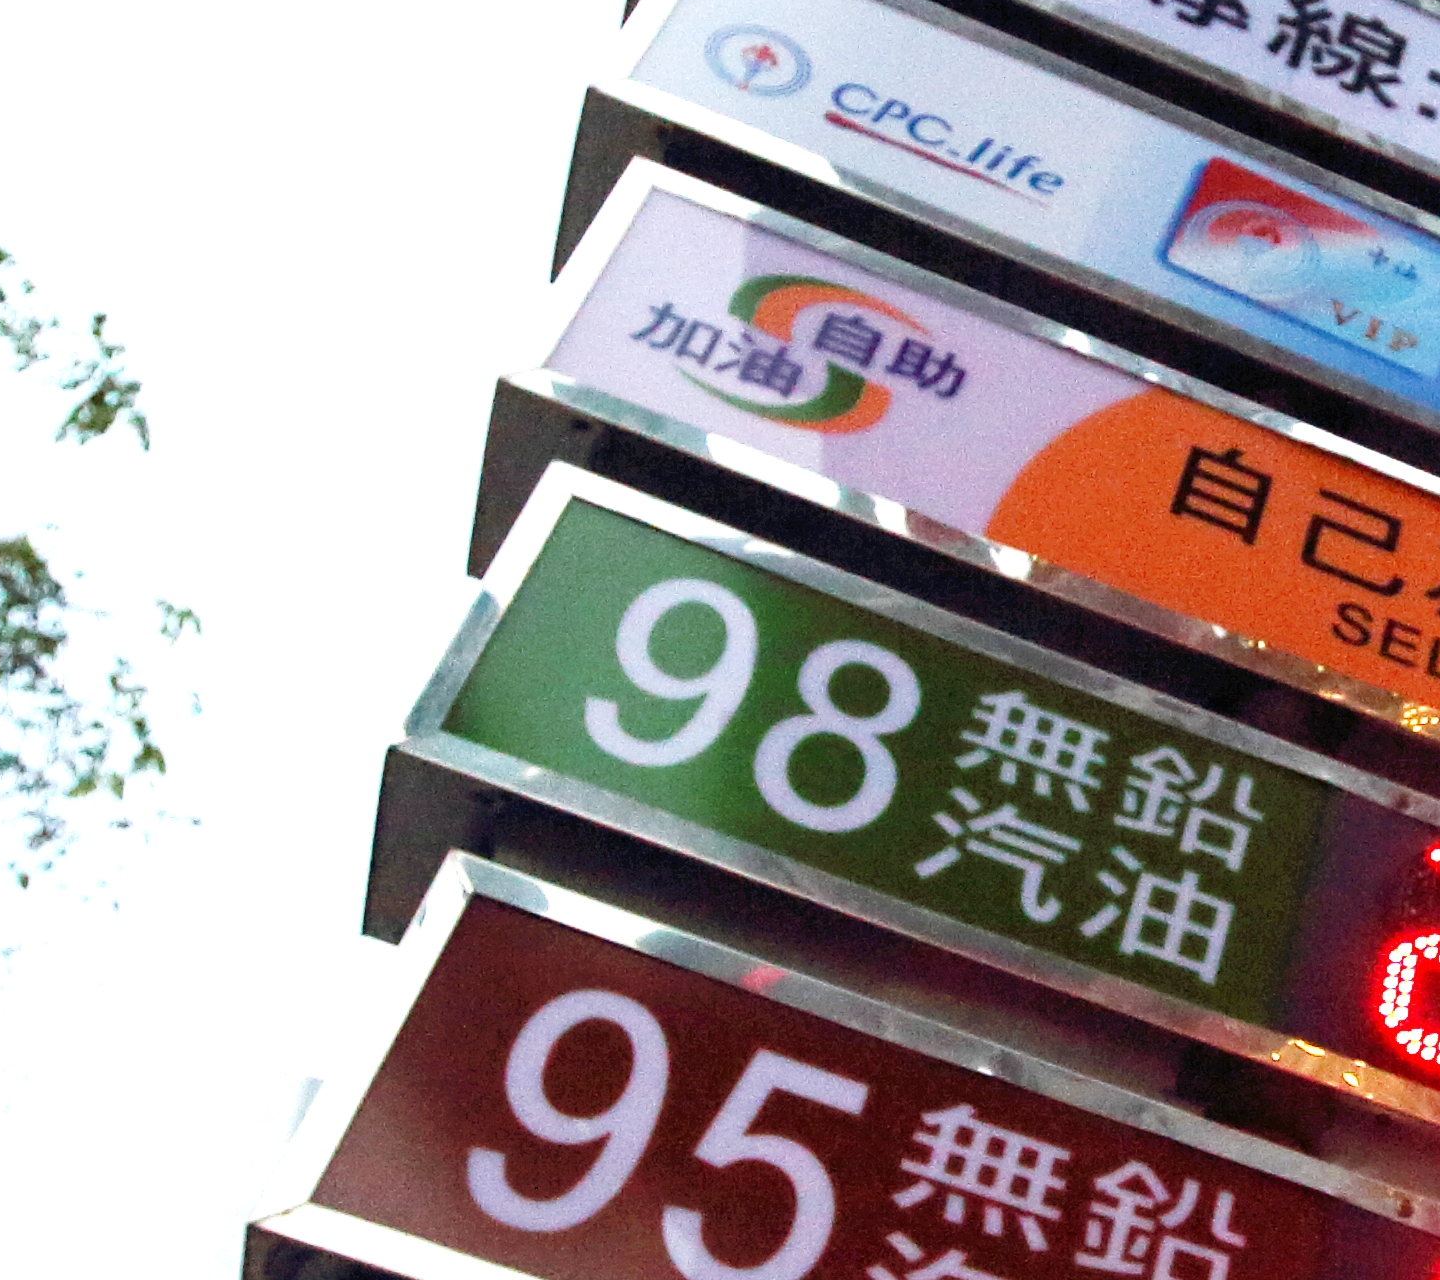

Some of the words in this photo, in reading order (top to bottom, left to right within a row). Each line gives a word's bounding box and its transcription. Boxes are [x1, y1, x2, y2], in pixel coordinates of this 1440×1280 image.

[628, 302, 804, 399] 加油
[813, 313, 967, 400] 自助
[584, 577, 921, 834] 98
[954, 689, 1264, 873] 無鉛
[914, 787, 1237, 985] 汽油
